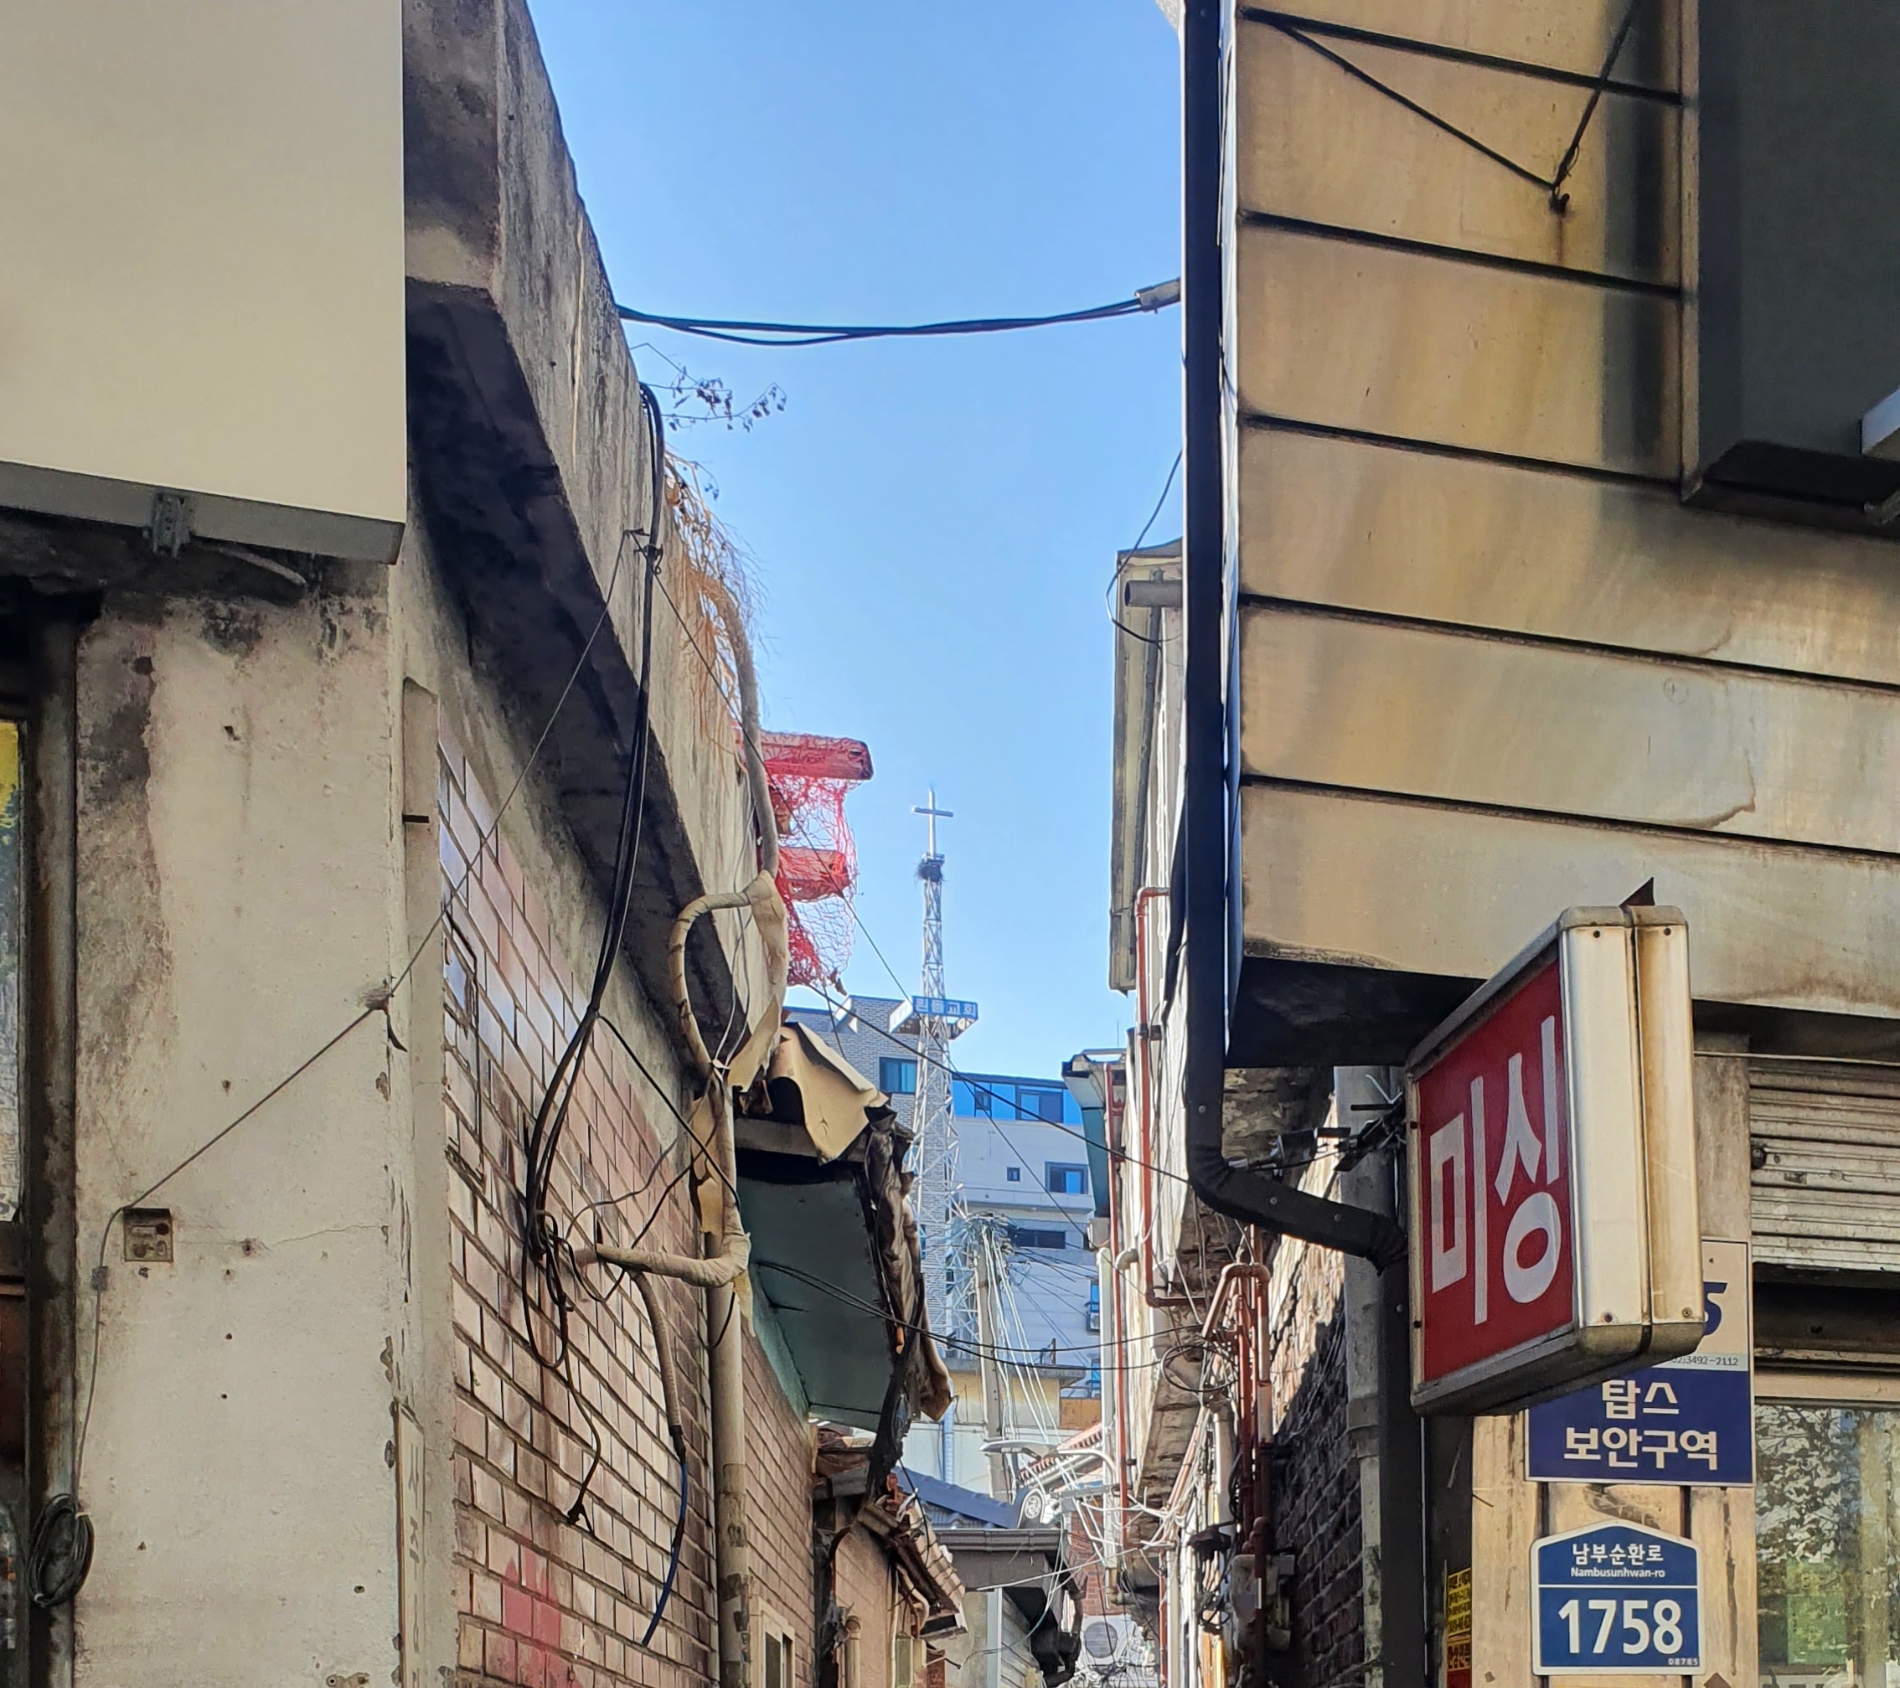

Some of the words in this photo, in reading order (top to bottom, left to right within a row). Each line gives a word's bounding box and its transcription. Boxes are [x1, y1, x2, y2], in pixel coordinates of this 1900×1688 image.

[1429, 1015, 1562, 1327] 미싱
[1601, 1379, 1680, 1420] 탑스
[1563, 1426, 1718, 1471] 보안구역
[1570, 1566, 1666, 1578] Nambusunhwan-ro
[1571, 1542, 1665, 1566] 남부순환로
[1557, 1599, 1684, 1655] 1758
